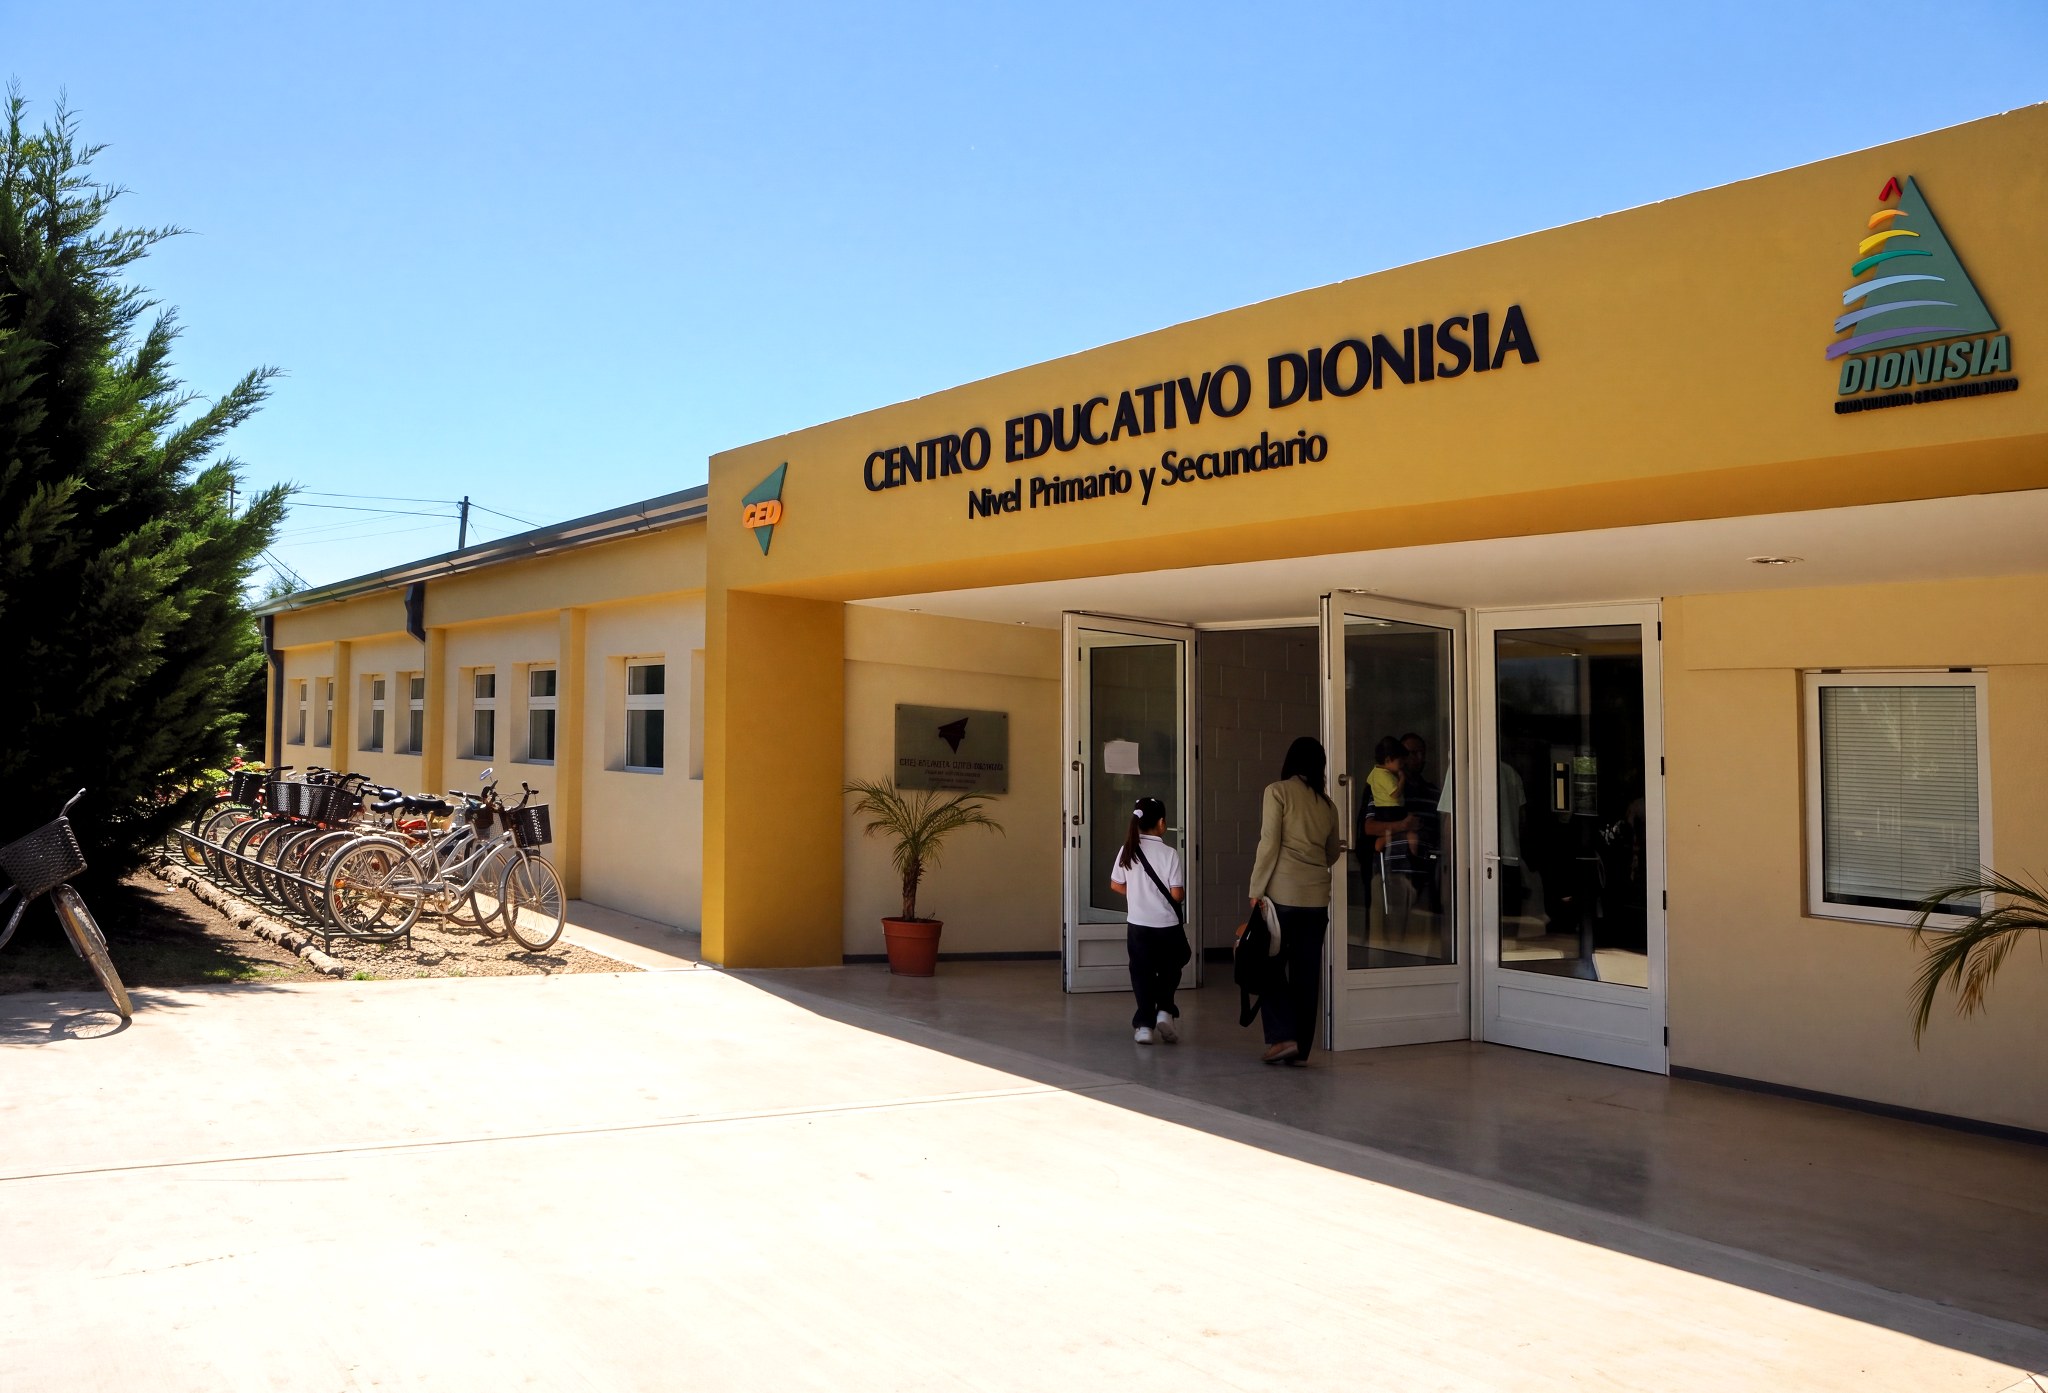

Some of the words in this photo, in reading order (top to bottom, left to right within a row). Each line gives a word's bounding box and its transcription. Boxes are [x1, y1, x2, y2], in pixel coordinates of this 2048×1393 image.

[863, 425, 992, 492] CENTRO
[1005, 364, 1252, 463] EDUCATIVO
[1267, 304, 1540, 410] DIONISIA
[1838, 335, 2010, 395] DIONISIA
[968, 477, 1022, 519] Nivel
[1029, 464, 1133, 509] Primario
[1138, 467, 1157, 506] y
[1160, 429, 1329, 487] Secundario
[742, 499, 783, 529] CED
